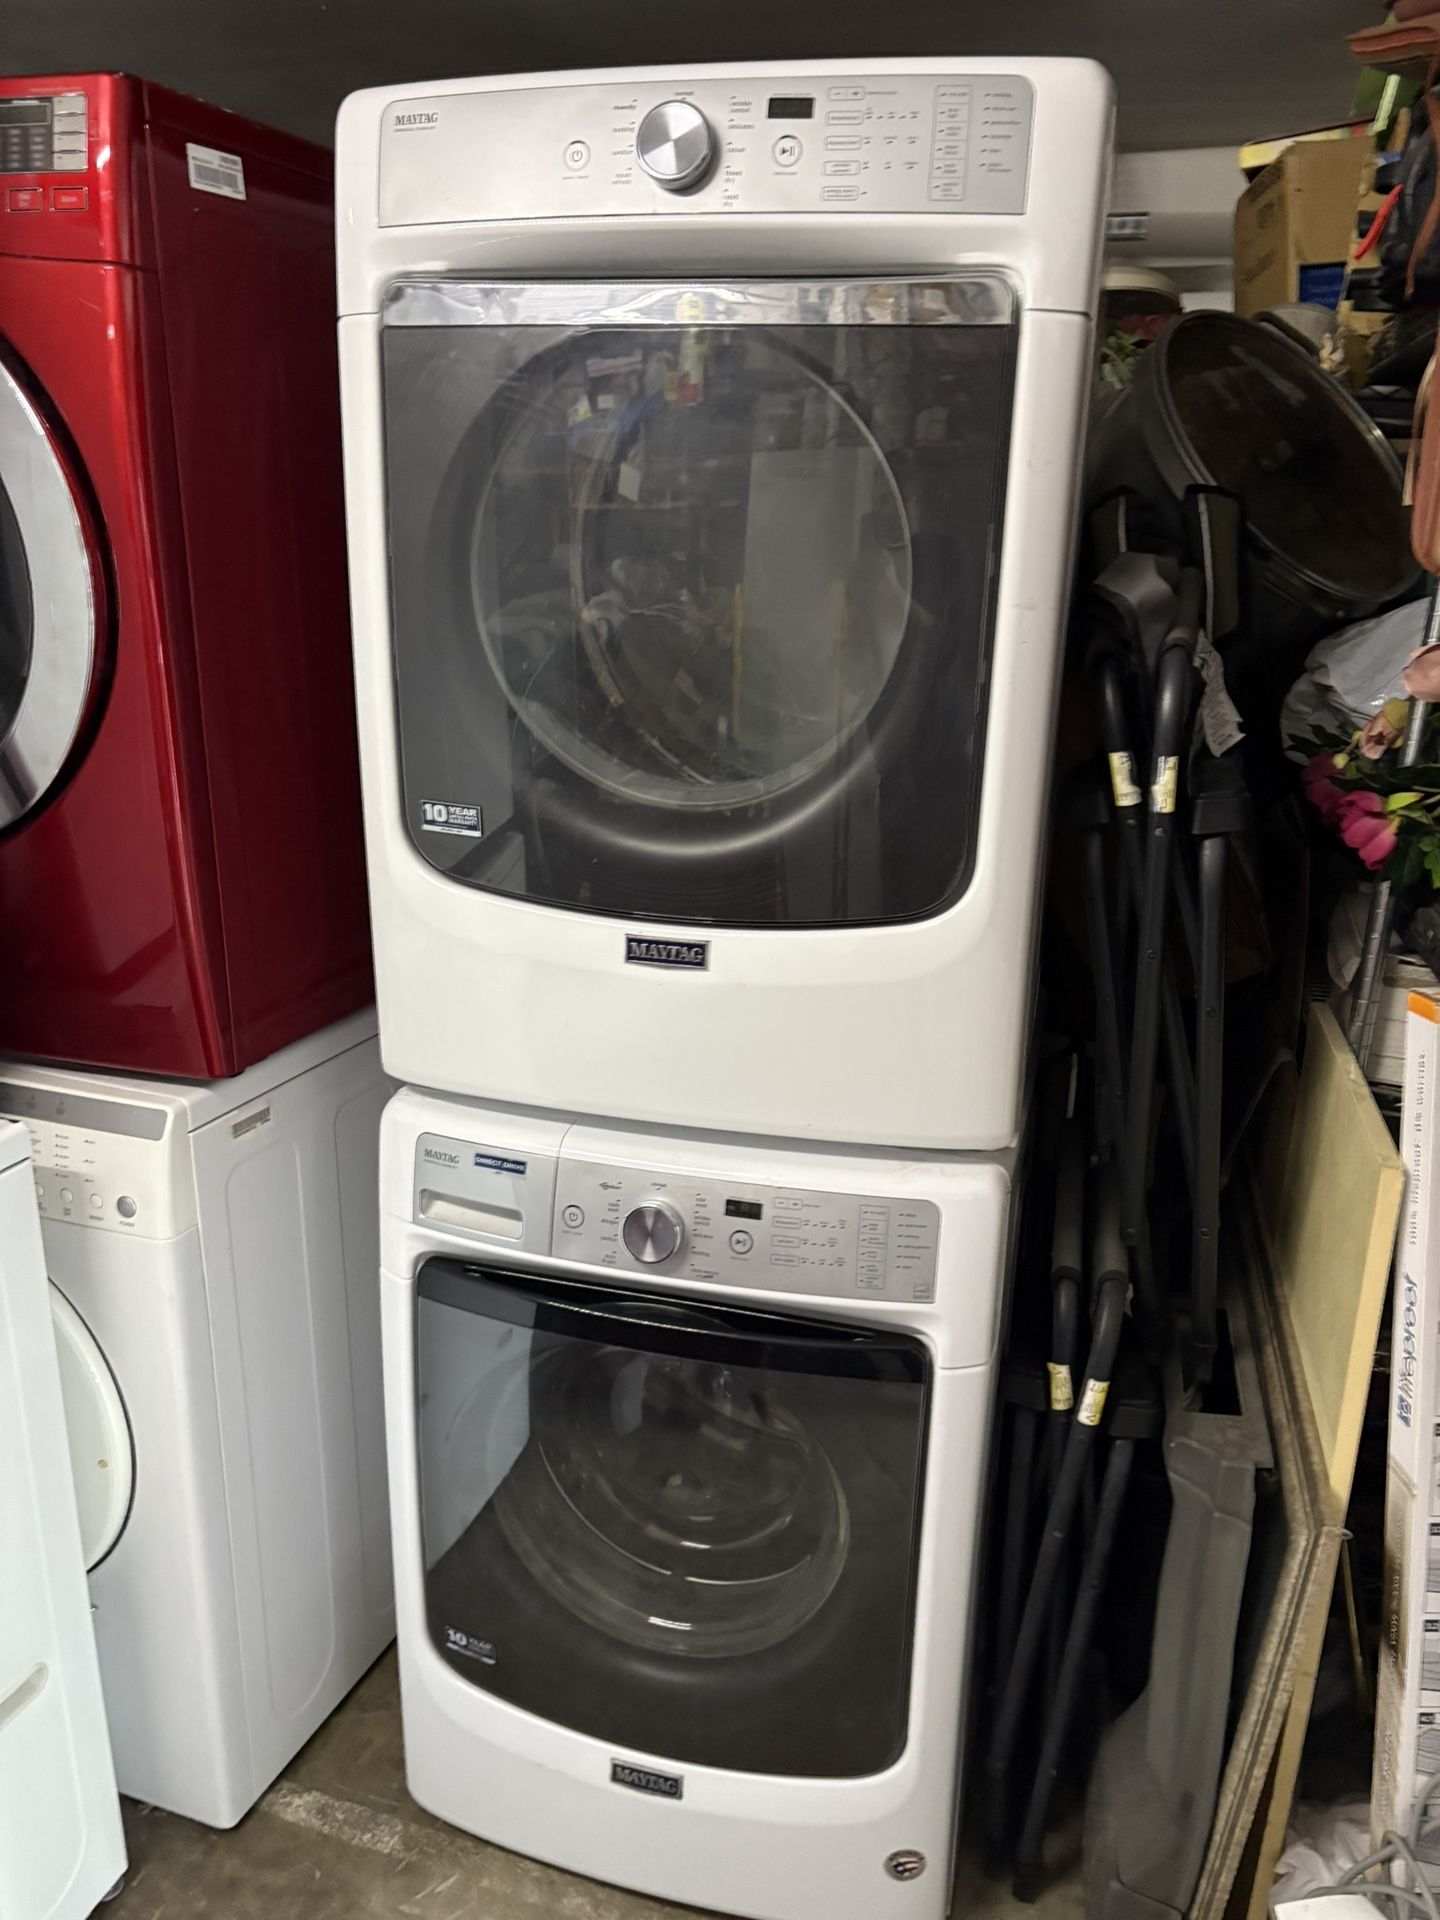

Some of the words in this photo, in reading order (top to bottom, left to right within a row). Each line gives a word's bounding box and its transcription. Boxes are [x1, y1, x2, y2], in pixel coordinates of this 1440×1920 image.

[395, 111, 439, 126] MAYTAG
[423, 803, 448, 823] 10
[448, 806, 477, 817] YEAR
[629, 942, 704, 962] MAYTAG
[423, 1148, 460, 1164] MAYTAG
[446, 1628, 468, 1647] 10
[614, 1766, 677, 1793] MAYTAG
